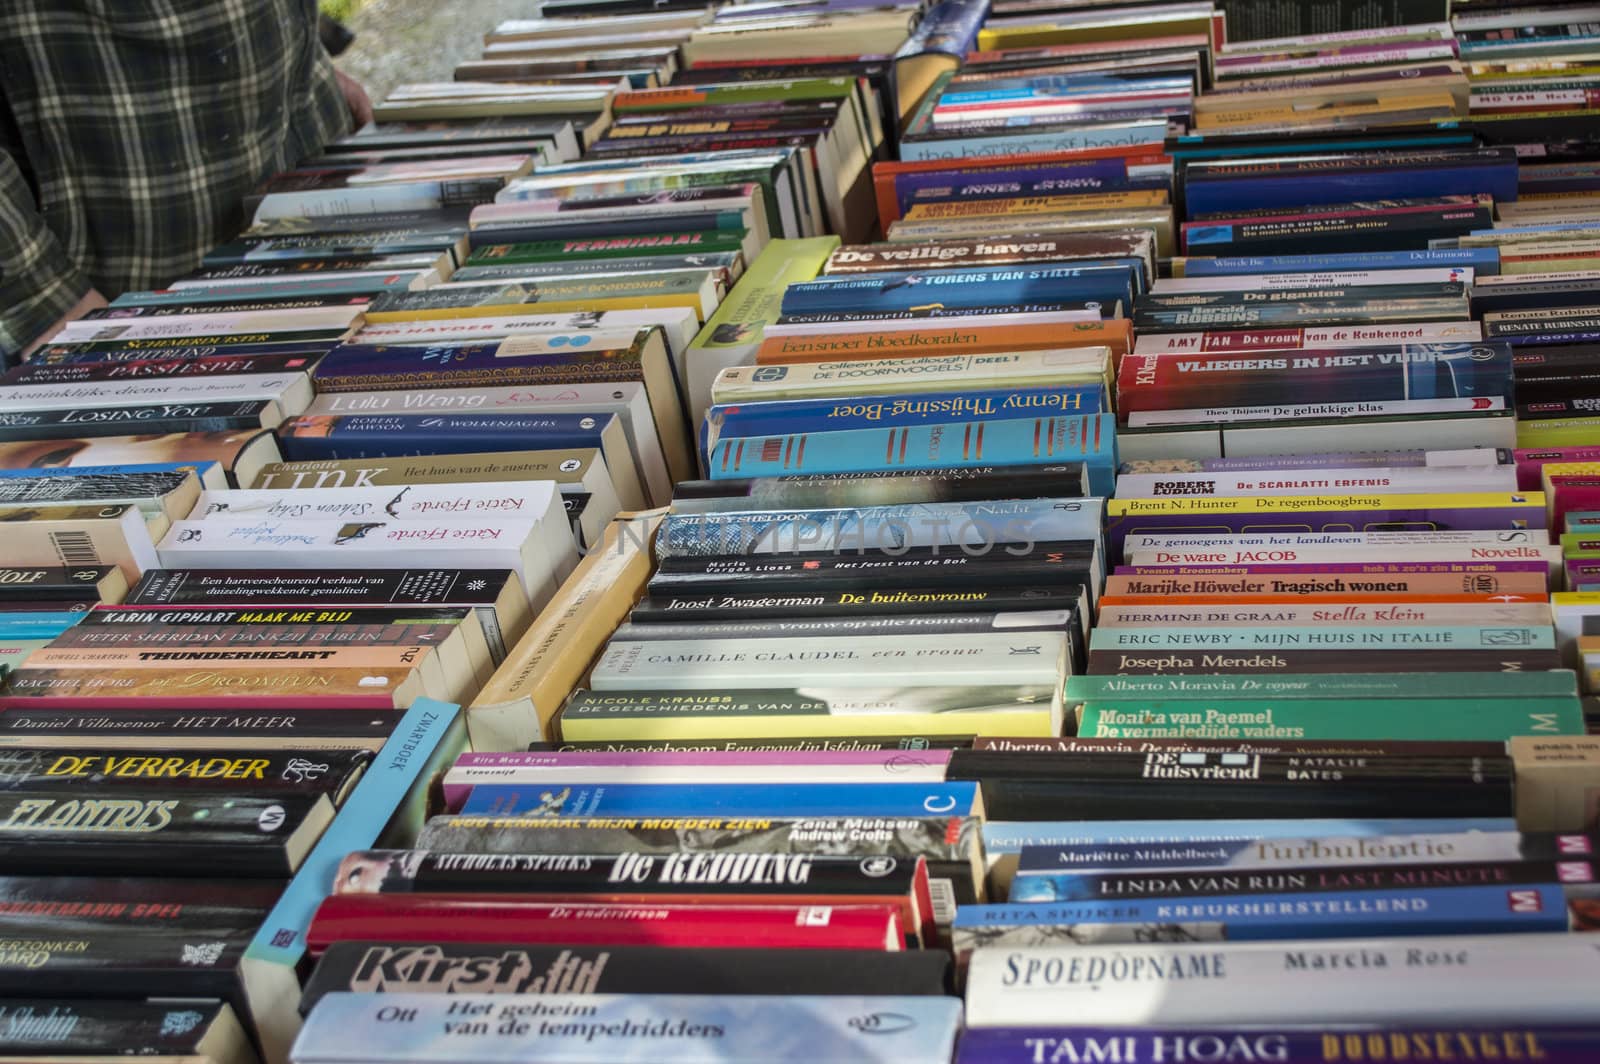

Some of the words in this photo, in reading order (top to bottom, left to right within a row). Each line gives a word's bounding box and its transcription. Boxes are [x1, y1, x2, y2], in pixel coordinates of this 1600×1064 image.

[1242, 222, 1295, 232] CHARLES
[1258, 228, 1291, 237] macht
[1355, 221, 1388, 230] Miller
[563, 234, 704, 253] TERMINAAL
[834, 248, 873, 264] De
[877, 242, 971, 262] veilige
[974, 240, 1058, 256] haven
[925, 273, 987, 286] TORENS
[992, 271, 1024, 282] VAN
[1029, 268, 1081, 279] STILTE
[1270, 290, 1345, 300] giganten
[788, 313, 841, 324] Cecilia
[844, 311, 914, 321] Samartin
[1022, 304, 1063, 314] Hart
[1175, 310, 1260, 324] ROBBINS
[782, 339, 815, 353] Een
[814, 339, 860, 350] snoer
[867, 331, 978, 347] bloedkoralen
[1168, 338, 1197, 348] AMY
[1204, 335, 1231, 346] TAN
[1243, 335, 1260, 344] De
[1264, 334, 1300, 343] vrouw
[1306, 333, 1328, 341] van
[1333, 331, 1347, 340] de
[1353, 328, 1423, 340] Keukengod
[101, 347, 217, 362] NACHTBLIND
[106, 359, 256, 377] PASSIESPEL
[1176, 358, 1288, 372] VLIEGERS
[1292, 358, 1320, 369] IN
[1324, 354, 1373, 367] HET
[813, 370, 838, 380] DE
[840, 363, 963, 378] DOORNVOGELS
[7, 385, 112, 400] koninklijke
[115, 384, 172, 395] dienst
[328, 396, 391, 411] Lulu
[402, 394, 488, 408] Wang
[827, 396, 997, 419] Thijssing-Boer
[1003, 392, 1083, 409] Henny
[59, 408, 158, 423] LOSING
[161, 405, 214, 417] YOU
[1273, 407, 1290, 415] De
[1293, 404, 1354, 416] gelukkige
[1358, 403, 1384, 412] klas
[1153, 481, 1216, 489] ROBERT
[1258, 480, 1329, 488] SCARLATTI
[1335, 478, 1390, 488] ERFENIS
[1153, 488, 1215, 496] LUDLUM
[1130, 501, 1166, 510] Brent
[1170, 500, 1186, 509] N.
[1190, 499, 1239, 509] Hunter
[1255, 499, 1274, 507] De
[1279, 496, 1381, 508] regenboogbrug
[1142, 538, 1162, 546] De
[1164, 537, 1234, 547] genoegens
[1239, 537, 1264, 545] van
[1269, 536, 1291, 545] het
[1296, 535, 1361, 545] landleven
[1156, 553, 1181, 562] De
[1184, 552, 1227, 562] ware
[1233, 551, 1297, 564] JACOB
[1471, 548, 1541, 558] Novella
[206, 587, 311, 597] duizelingwekkende
[313, 585, 369, 596] genialiteit
[1126, 581, 1191, 595] Marijke
[1194, 580, 1265, 593] Höweler
[1271, 579, 1346, 594] Tragisch
[1348, 580, 1409, 592] wonen
[665, 598, 715, 612] Joost
[720, 594, 825, 610] Zwagerman
[839, 592, 865, 605] De
[870, 589, 988, 604] buitenvrouw
[102, 612, 156, 623] KARIN
[159, 611, 237, 623] GIPHART
[236, 611, 284, 623] MAAK
[287, 611, 315, 623] ME
[314, 612, 353, 622] BLIJ
[1118, 614, 1202, 622] HERMINE
[1207, 613, 1229, 621] DE
[1234, 613, 1297, 621] GRAAF
[1312, 606, 1366, 621] Stella
[1375, 606, 1425, 621] Klein
[1118, 634, 1161, 644] ERIC
[1166, 634, 1233, 644] NEWBY
[1253, 633, 1300, 645] MIJN
[1308, 632, 1355, 644] HUIS
[1362, 633, 1384, 643] IN
[1392, 631, 1454, 643] ITALIË
[647, 652, 747, 665] CAMILLE
[754, 650, 861, 663] CLAUDEL
[871, 648, 907, 659] een
[916, 646, 985, 657] vrouw
[1119, 655, 1194, 671] Josepha
[1201, 655, 1288, 668] Mendels
[583, 696, 653, 705] NICOLE
[658, 695, 733, 704] KRAUSS
[11, 718, 74, 729] Daniel
[77, 718, 165, 729] Villasenor
[172, 716, 227, 729] HET
[228, 716, 297, 729] MEER
[1099, 709, 1166, 725] Monika
[1169, 711, 1201, 725] van
[1205, 709, 1273, 725] Paemel
[1096, 725, 1119, 738] De
[1121, 724, 1241, 739] vermaledijde
[1243, 725, 1304, 738] vaders
[389, 711, 439, 770] ZWARTBOEK
[46, 756, 101, 776] DE
[103, 756, 271, 779] VERRADER
[1141, 756, 1261, 779] Huisvriend
[1289, 757, 1368, 767] NATALIE
[1286, 770, 1344, 780] BATES
[788, 829, 847, 841] Andrew
[849, 829, 894, 841] Crofts
[1101, 878, 1181, 894] LINDA
[1188, 876, 1240, 890] VAN
[1249, 874, 1306, 888] RIJN
[1318, 872, 1384, 887] LAST
[1393, 868, 1512, 885] MINUTE
[984, 909, 1043, 921] RITA
[1047, 907, 1141, 919] SPIJKER
[1156, 897, 1428, 918] KREUKHERSTELLEND
[376, 1006, 419, 1022] Ott
[446, 1001, 495, 1016] Het
[500, 1001, 599, 1019] geheim
[443, 1023, 488, 1035] van
[497, 1020, 531, 1036] de
[538, 1018, 725, 1043] tempelridders
[1024, 1036, 1138, 1064] TAMI
[1152, 1035, 1288, 1062] HOAG
[1322, 1032, 1546, 1059] DOODSENGEL
